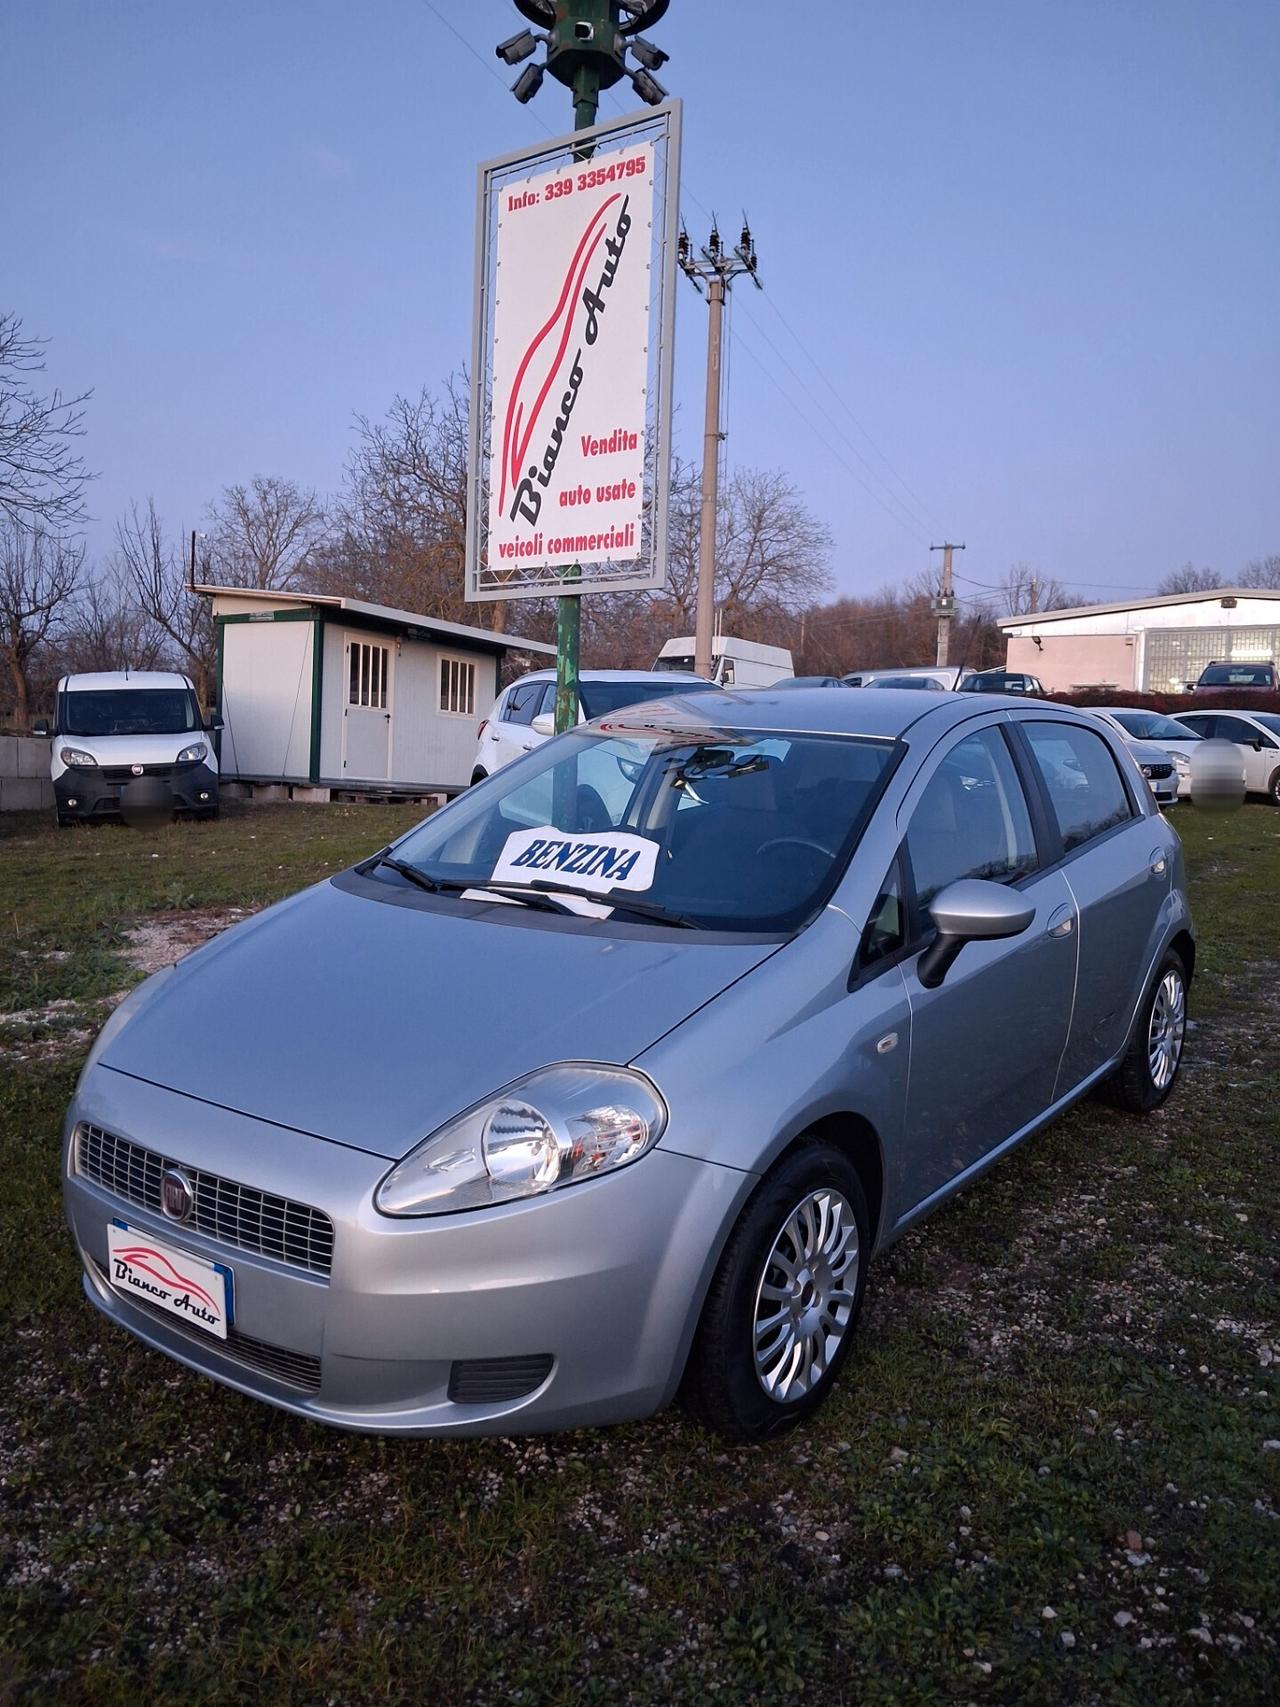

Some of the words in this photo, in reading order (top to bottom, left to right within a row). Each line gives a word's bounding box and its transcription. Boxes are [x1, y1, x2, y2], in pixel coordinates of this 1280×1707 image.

[508, 191, 540, 212] Info:
[544, 178, 573, 201] 339
[577, 156, 646, 192] 3354795
[510, 347, 584, 527] Bianco
[582, 194, 631, 345] Auto
[581, 428, 637, 457] Vendita
[559, 485, 591, 507] auto
[596, 479, 636, 503] usate
[499, 532, 543, 558] veicoli
[547, 523, 635, 554] commerciali
[510, 839, 641, 881] BENZINA
[113, 1258, 172, 1300] Bianco
[174, 1294, 221, 1325] Auto
